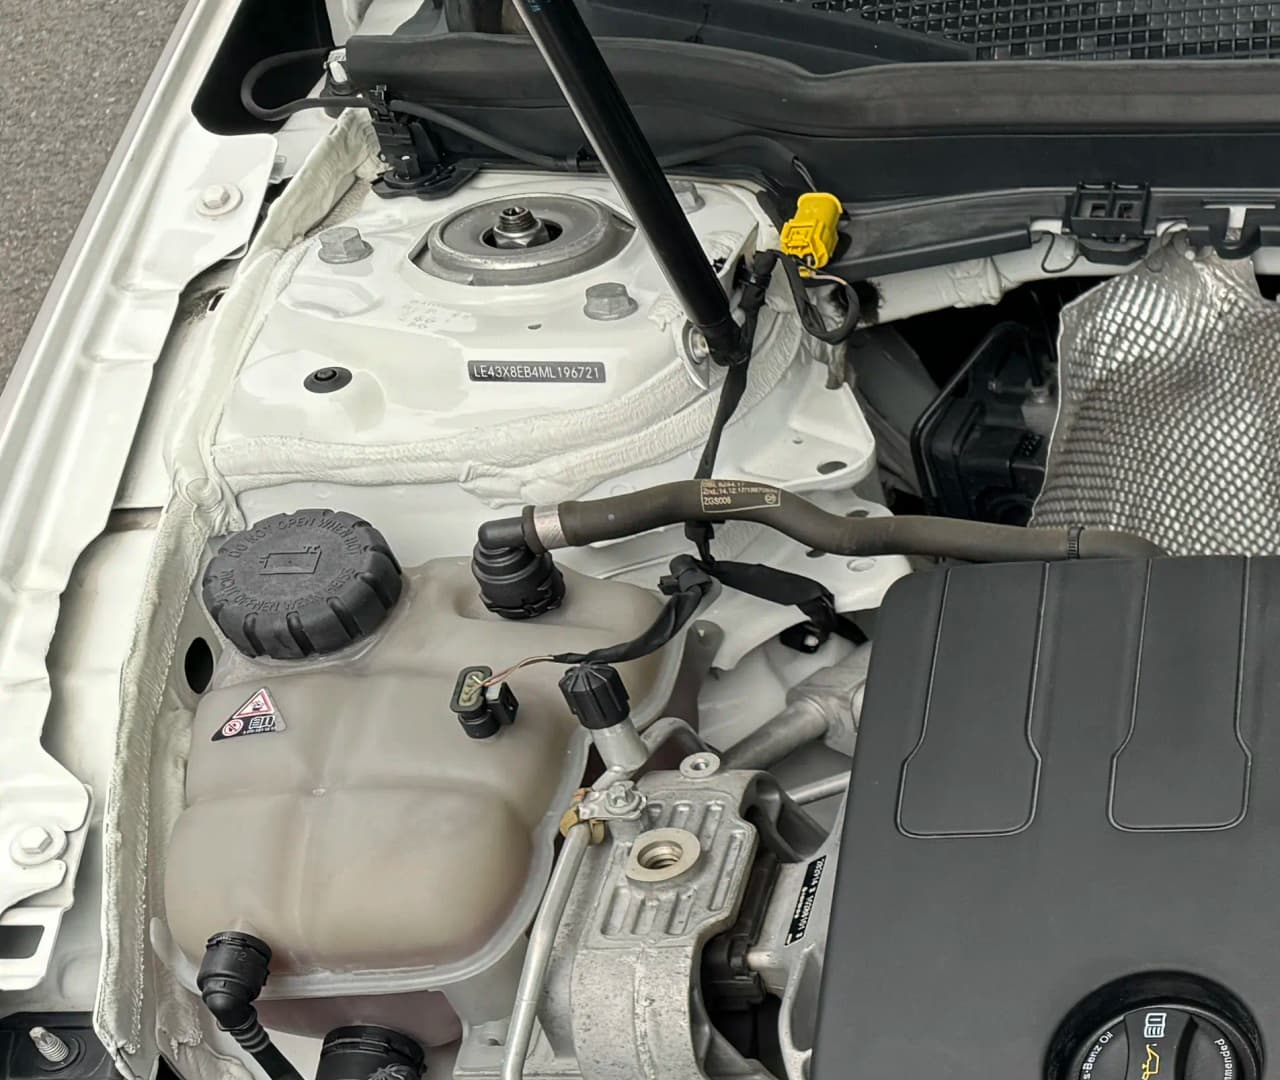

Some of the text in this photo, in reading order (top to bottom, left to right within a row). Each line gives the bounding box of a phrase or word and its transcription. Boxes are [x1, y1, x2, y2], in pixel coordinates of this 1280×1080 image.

[474, 364, 600, 379] LE43X8EB4ML196721
[278, 518, 315, 530] OPEN
[319, 518, 351, 542] WHEN
[1100, 1031, 1114, 1044] Oil
